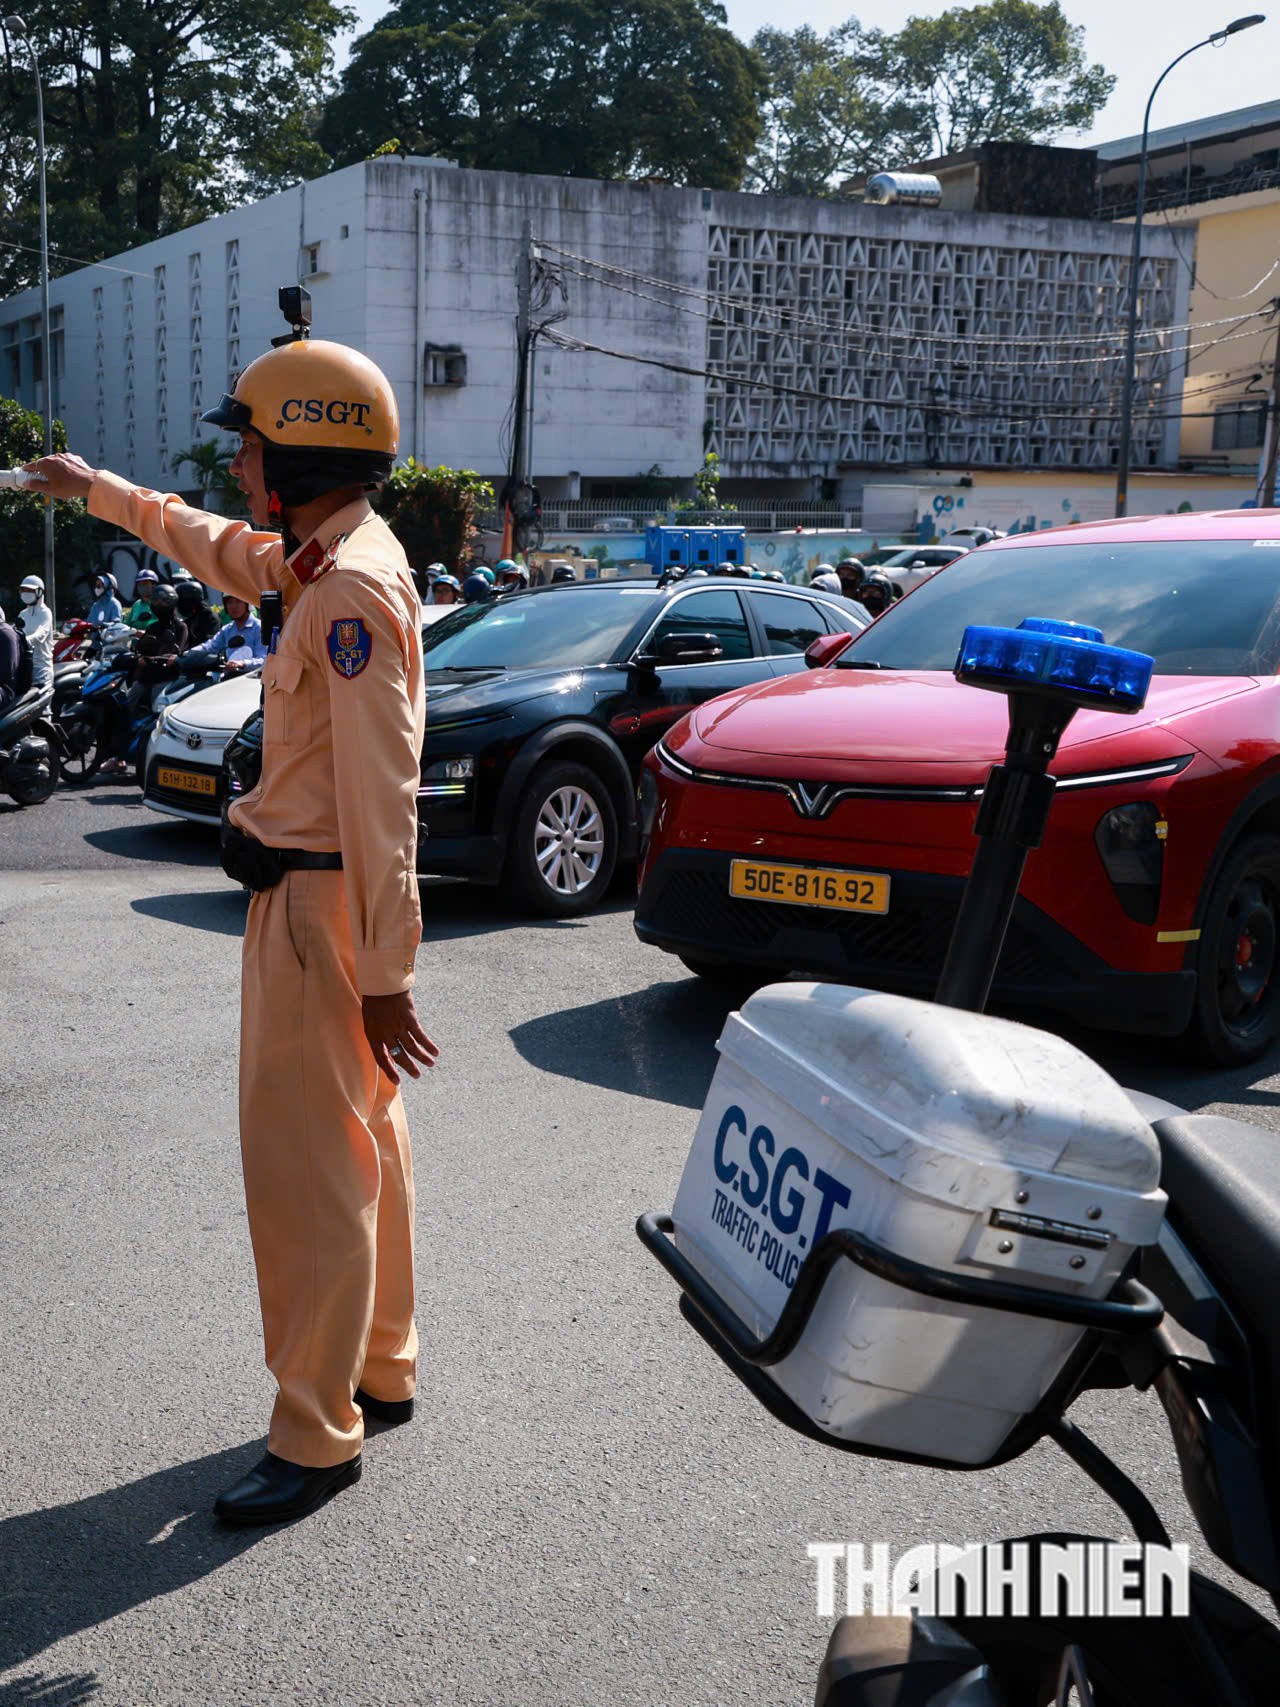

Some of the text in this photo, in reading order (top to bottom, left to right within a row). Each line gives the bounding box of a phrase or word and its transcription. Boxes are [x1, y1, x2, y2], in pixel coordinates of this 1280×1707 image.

[281, 399, 370, 426] CSGT
[744, 868, 875, 905] 50E-816.92
[714, 1105, 852, 1252] C.S.G.T
[711, 1188, 805, 1289] TRAFFIC POLIC
